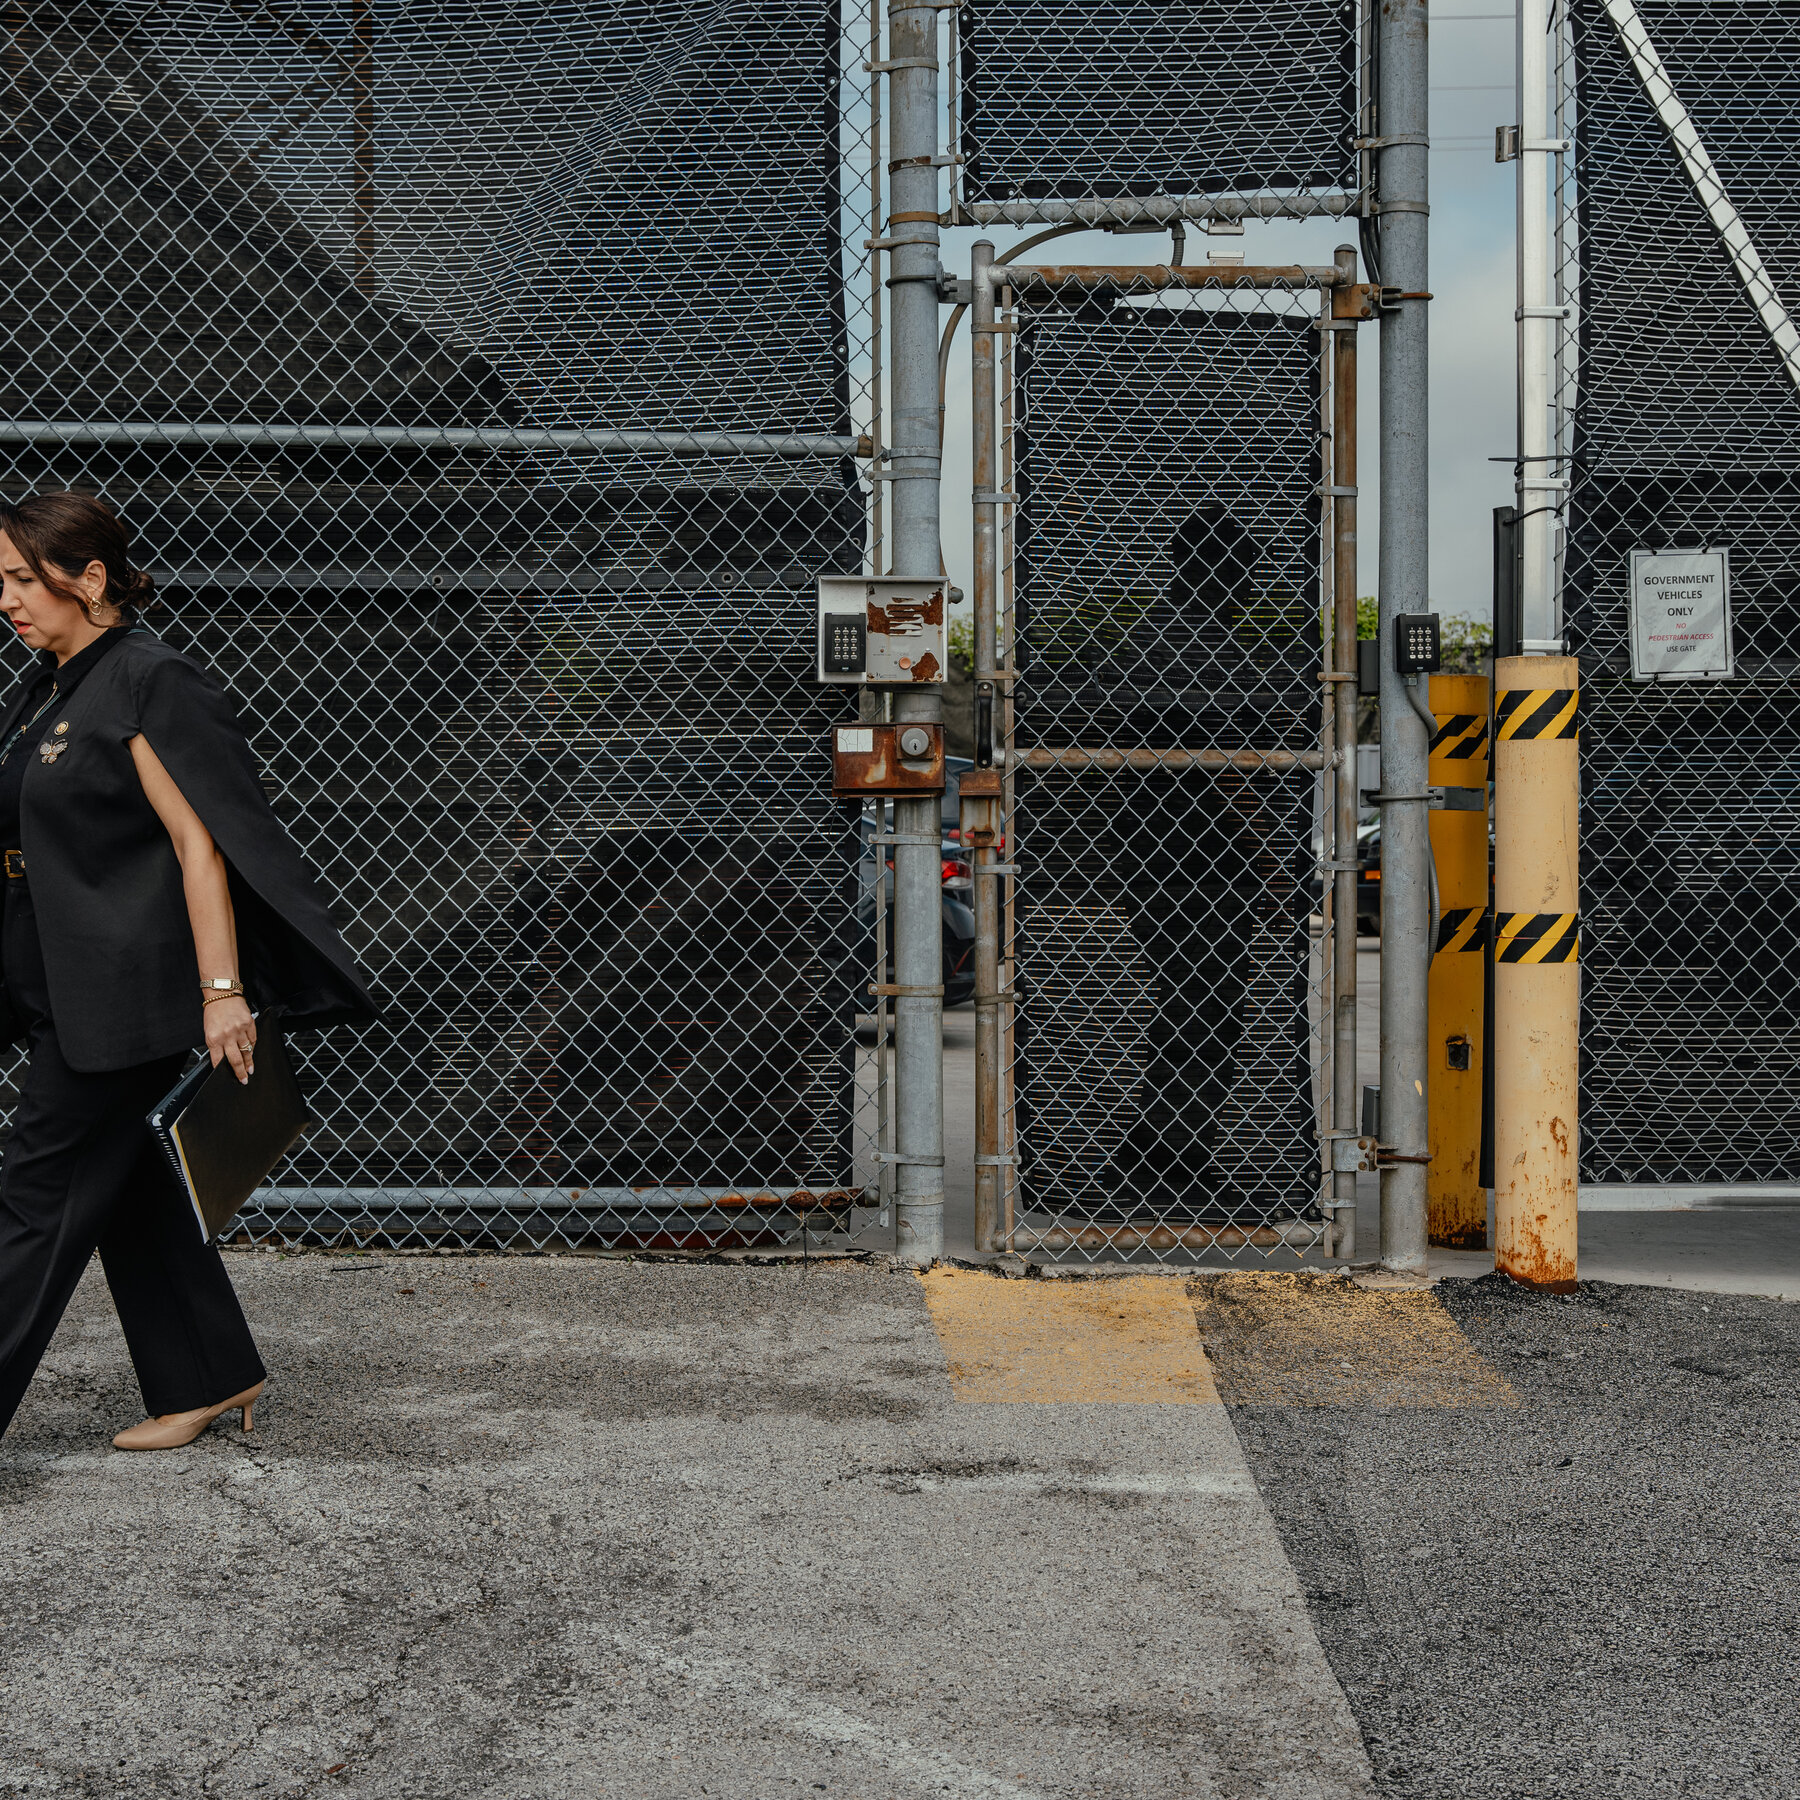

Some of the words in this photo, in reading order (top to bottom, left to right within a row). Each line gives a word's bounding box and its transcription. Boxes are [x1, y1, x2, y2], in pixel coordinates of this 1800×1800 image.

[1644, 574, 1715, 585] GOVERNMENT
[1657, 590, 1703, 600] VEHICLES
[1667, 607, 1694, 616] ONLY
